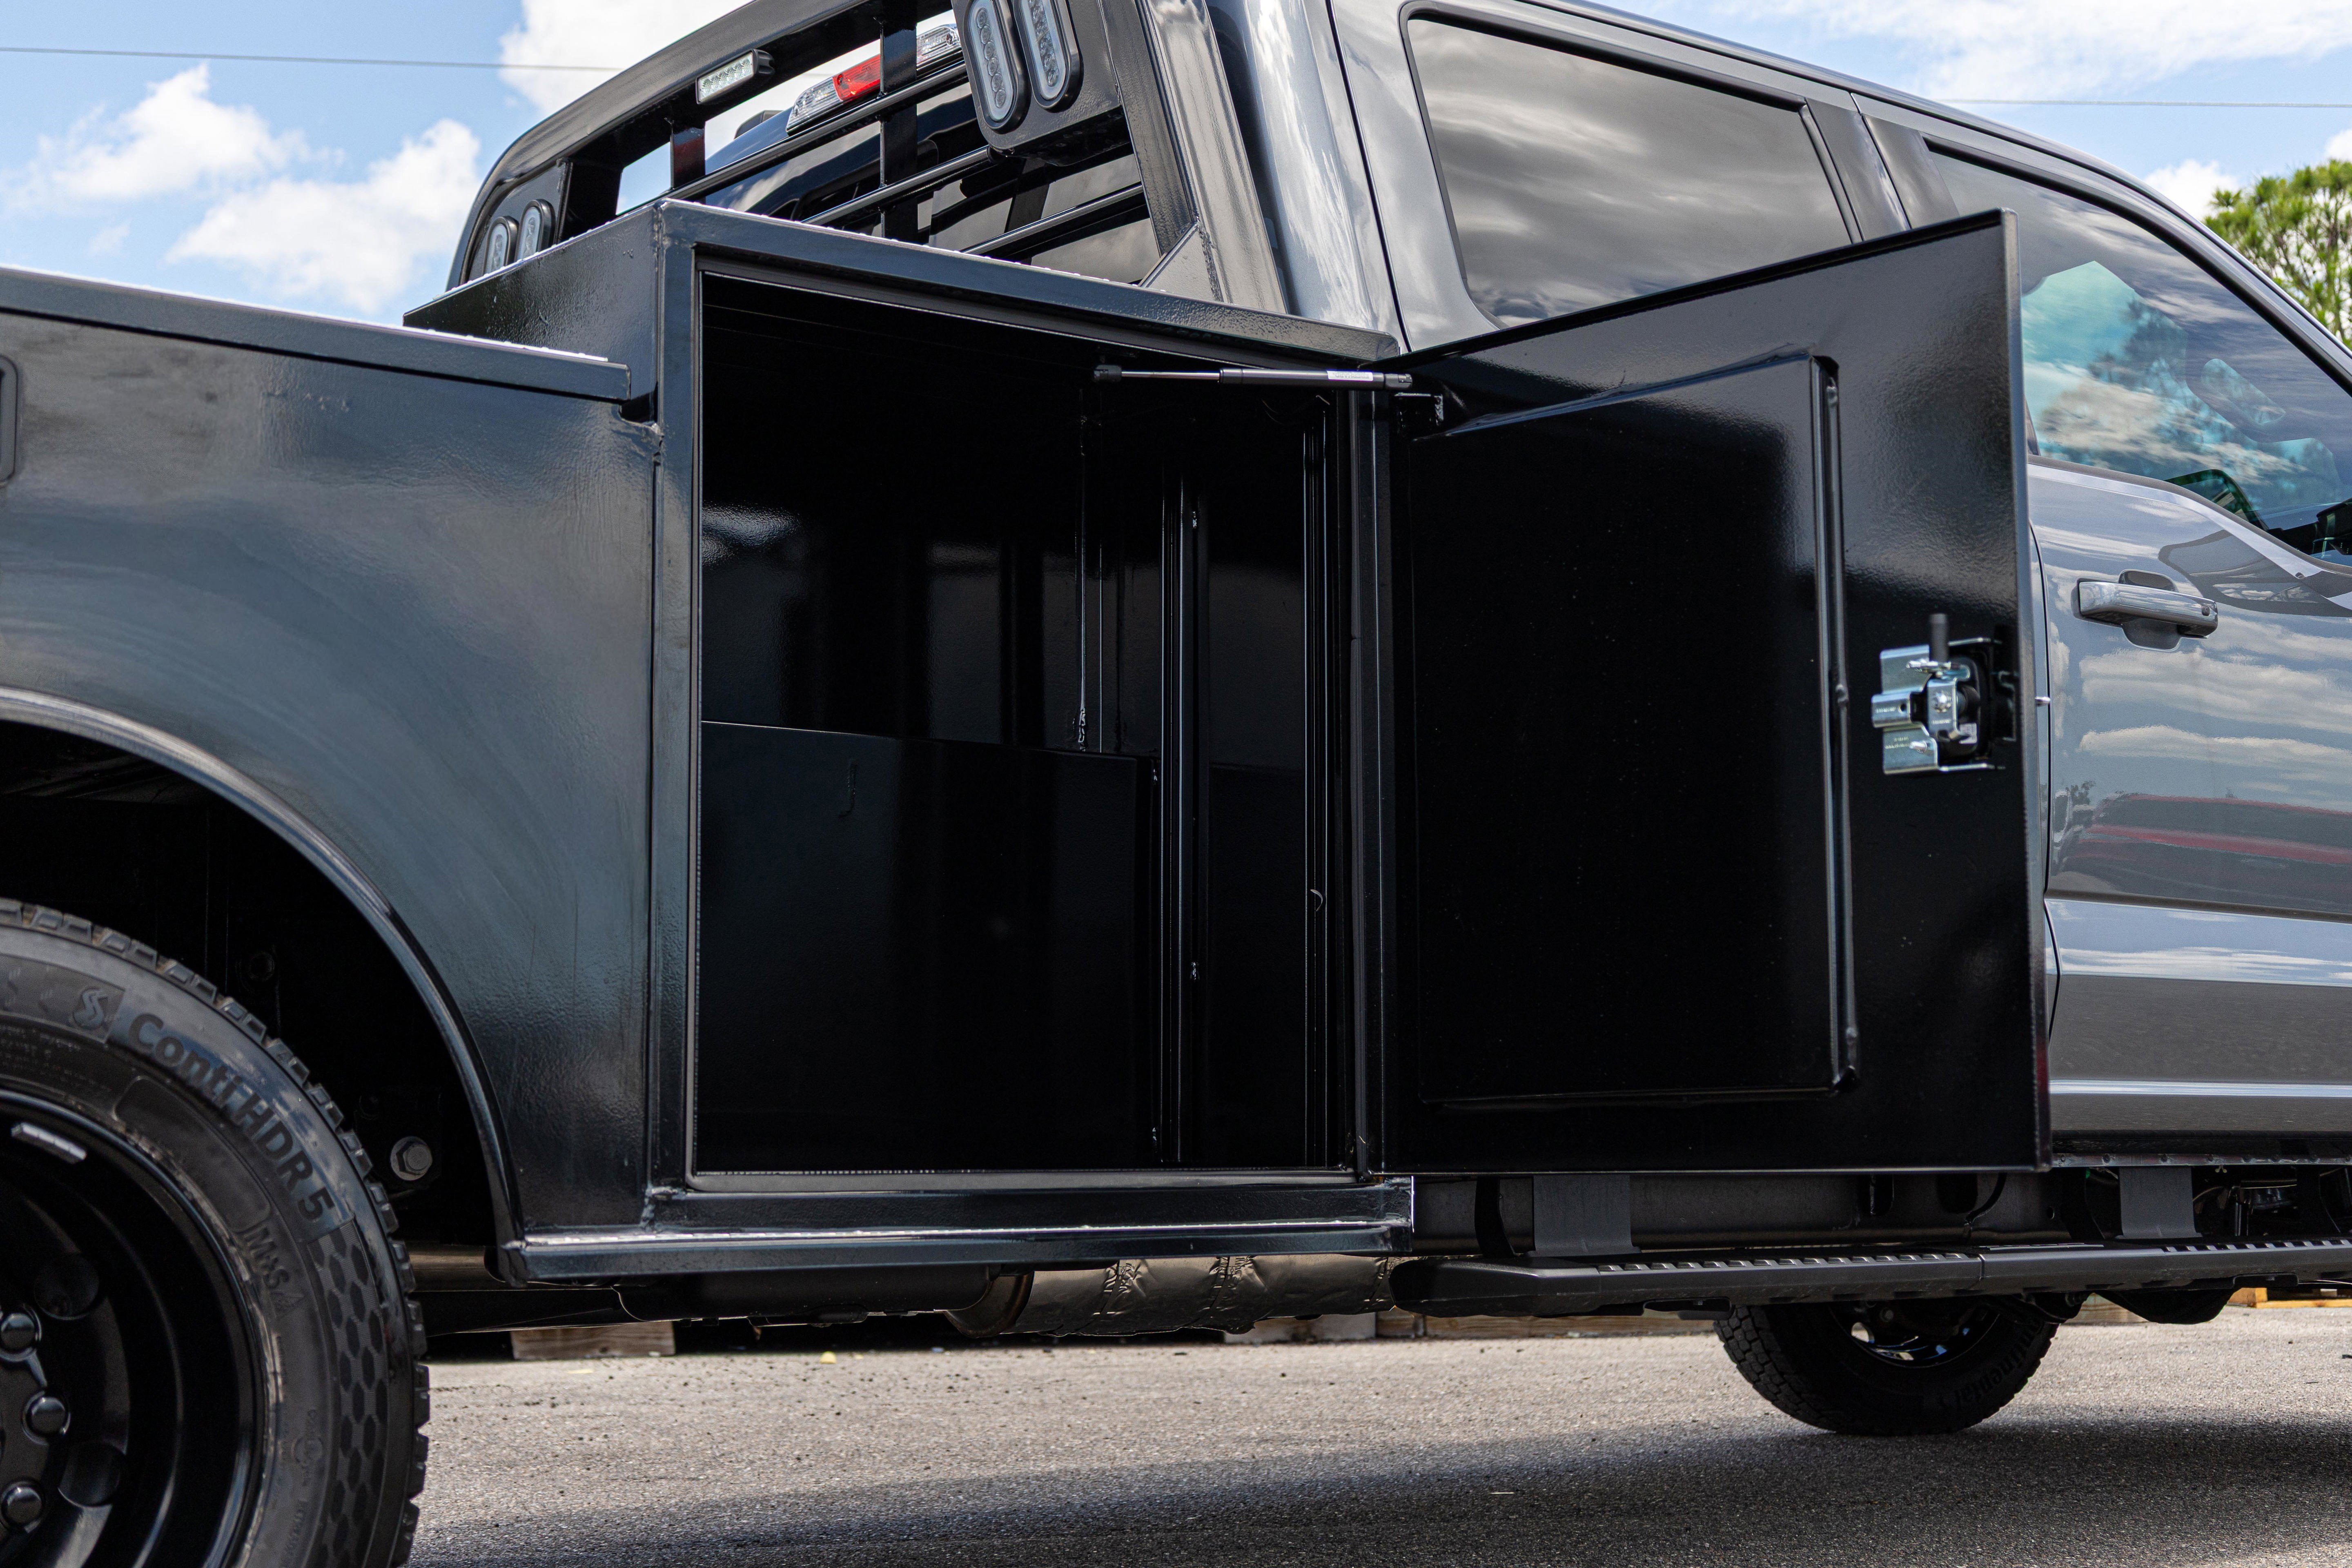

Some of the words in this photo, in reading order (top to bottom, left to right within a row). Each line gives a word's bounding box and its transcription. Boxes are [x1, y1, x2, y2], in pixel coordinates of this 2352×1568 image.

[128, 1013, 243, 1108] Conti
[231, 1094, 314, 1189] HDR
[297, 1186, 336, 1223] 5
